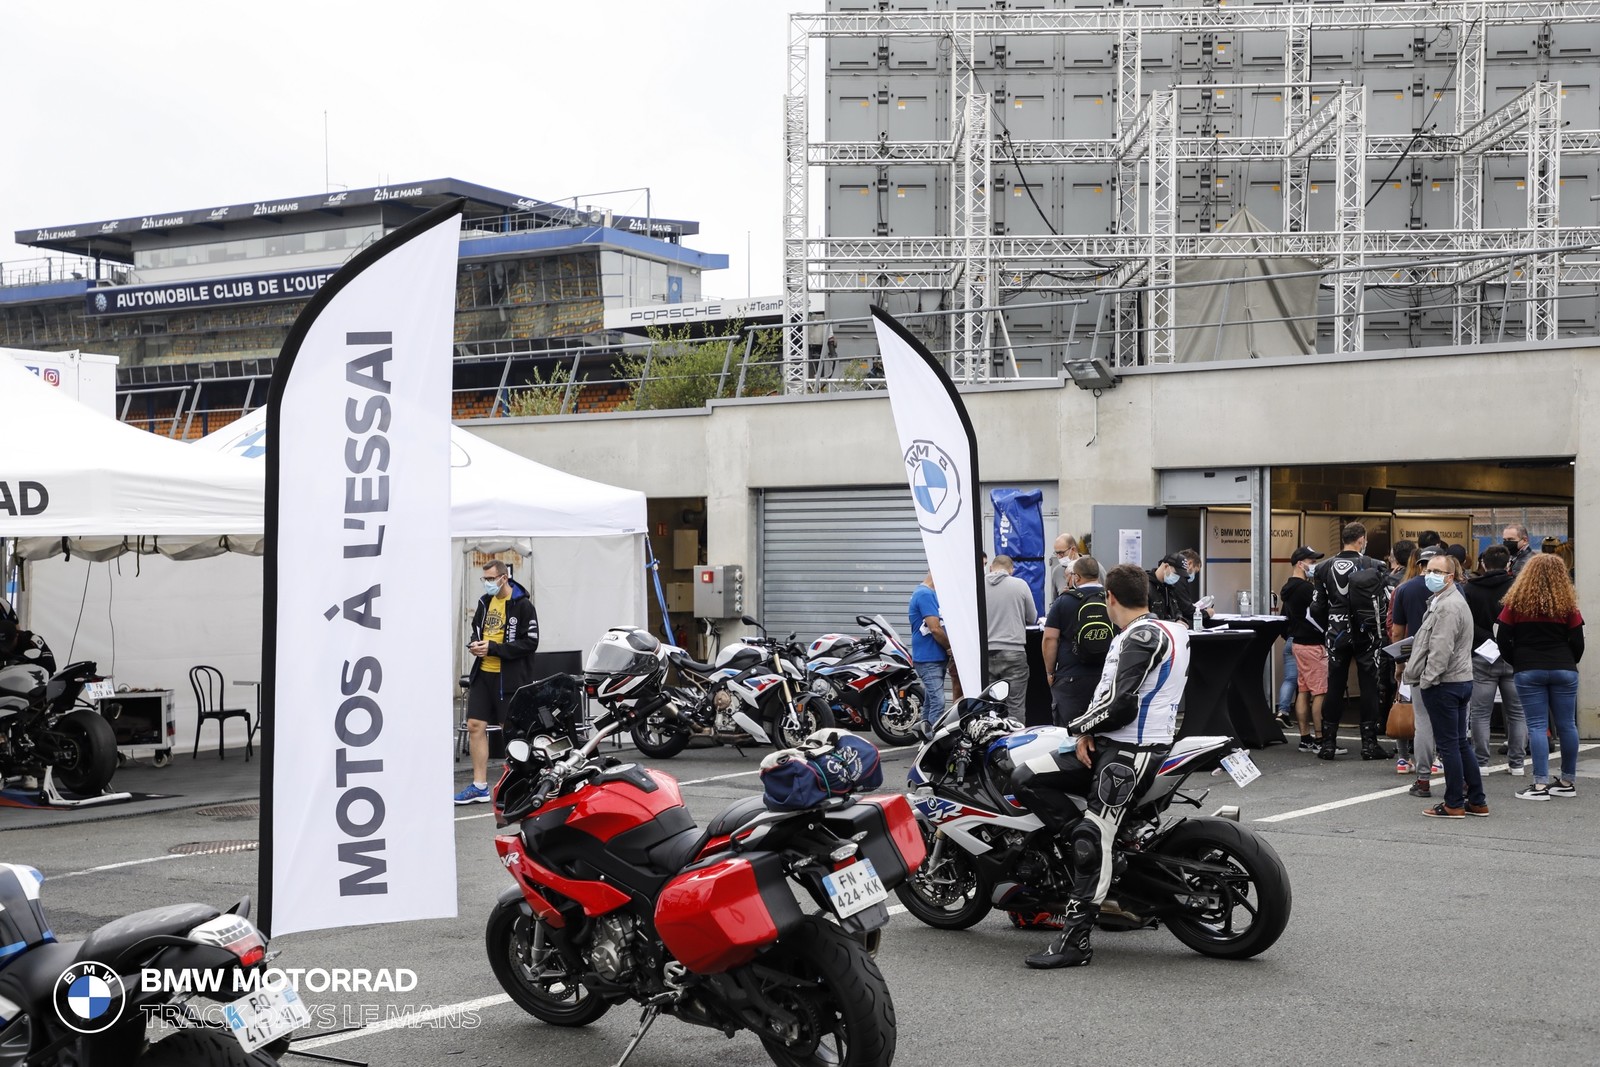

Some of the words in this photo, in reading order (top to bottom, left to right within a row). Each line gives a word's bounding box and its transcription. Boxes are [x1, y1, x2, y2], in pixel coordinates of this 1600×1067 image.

[389, 190, 399, 200] LE
[399, 187, 423, 198] MANS
[267, 205, 277, 214] LE
[277, 202, 299, 212] MANS
[155, 219, 164, 228] LE
[164, 217, 184, 226] MANS
[58, 230, 77, 239] MANS
[117, 286, 209, 308] AUTOMOBILE
[214, 282, 254, 299] CLUB
[258, 279, 279, 296] DE
[630, 305, 721, 321] PORSCHE
[343, 331, 393, 559] L'ESSAI
[1280, 529, 1294, 538] DAYS
[323, 583, 382, 631] À
[1084, 628, 1108, 640] 46
[334, 655, 389, 897] MOTOS
[837, 878, 882, 908] 424-KK
